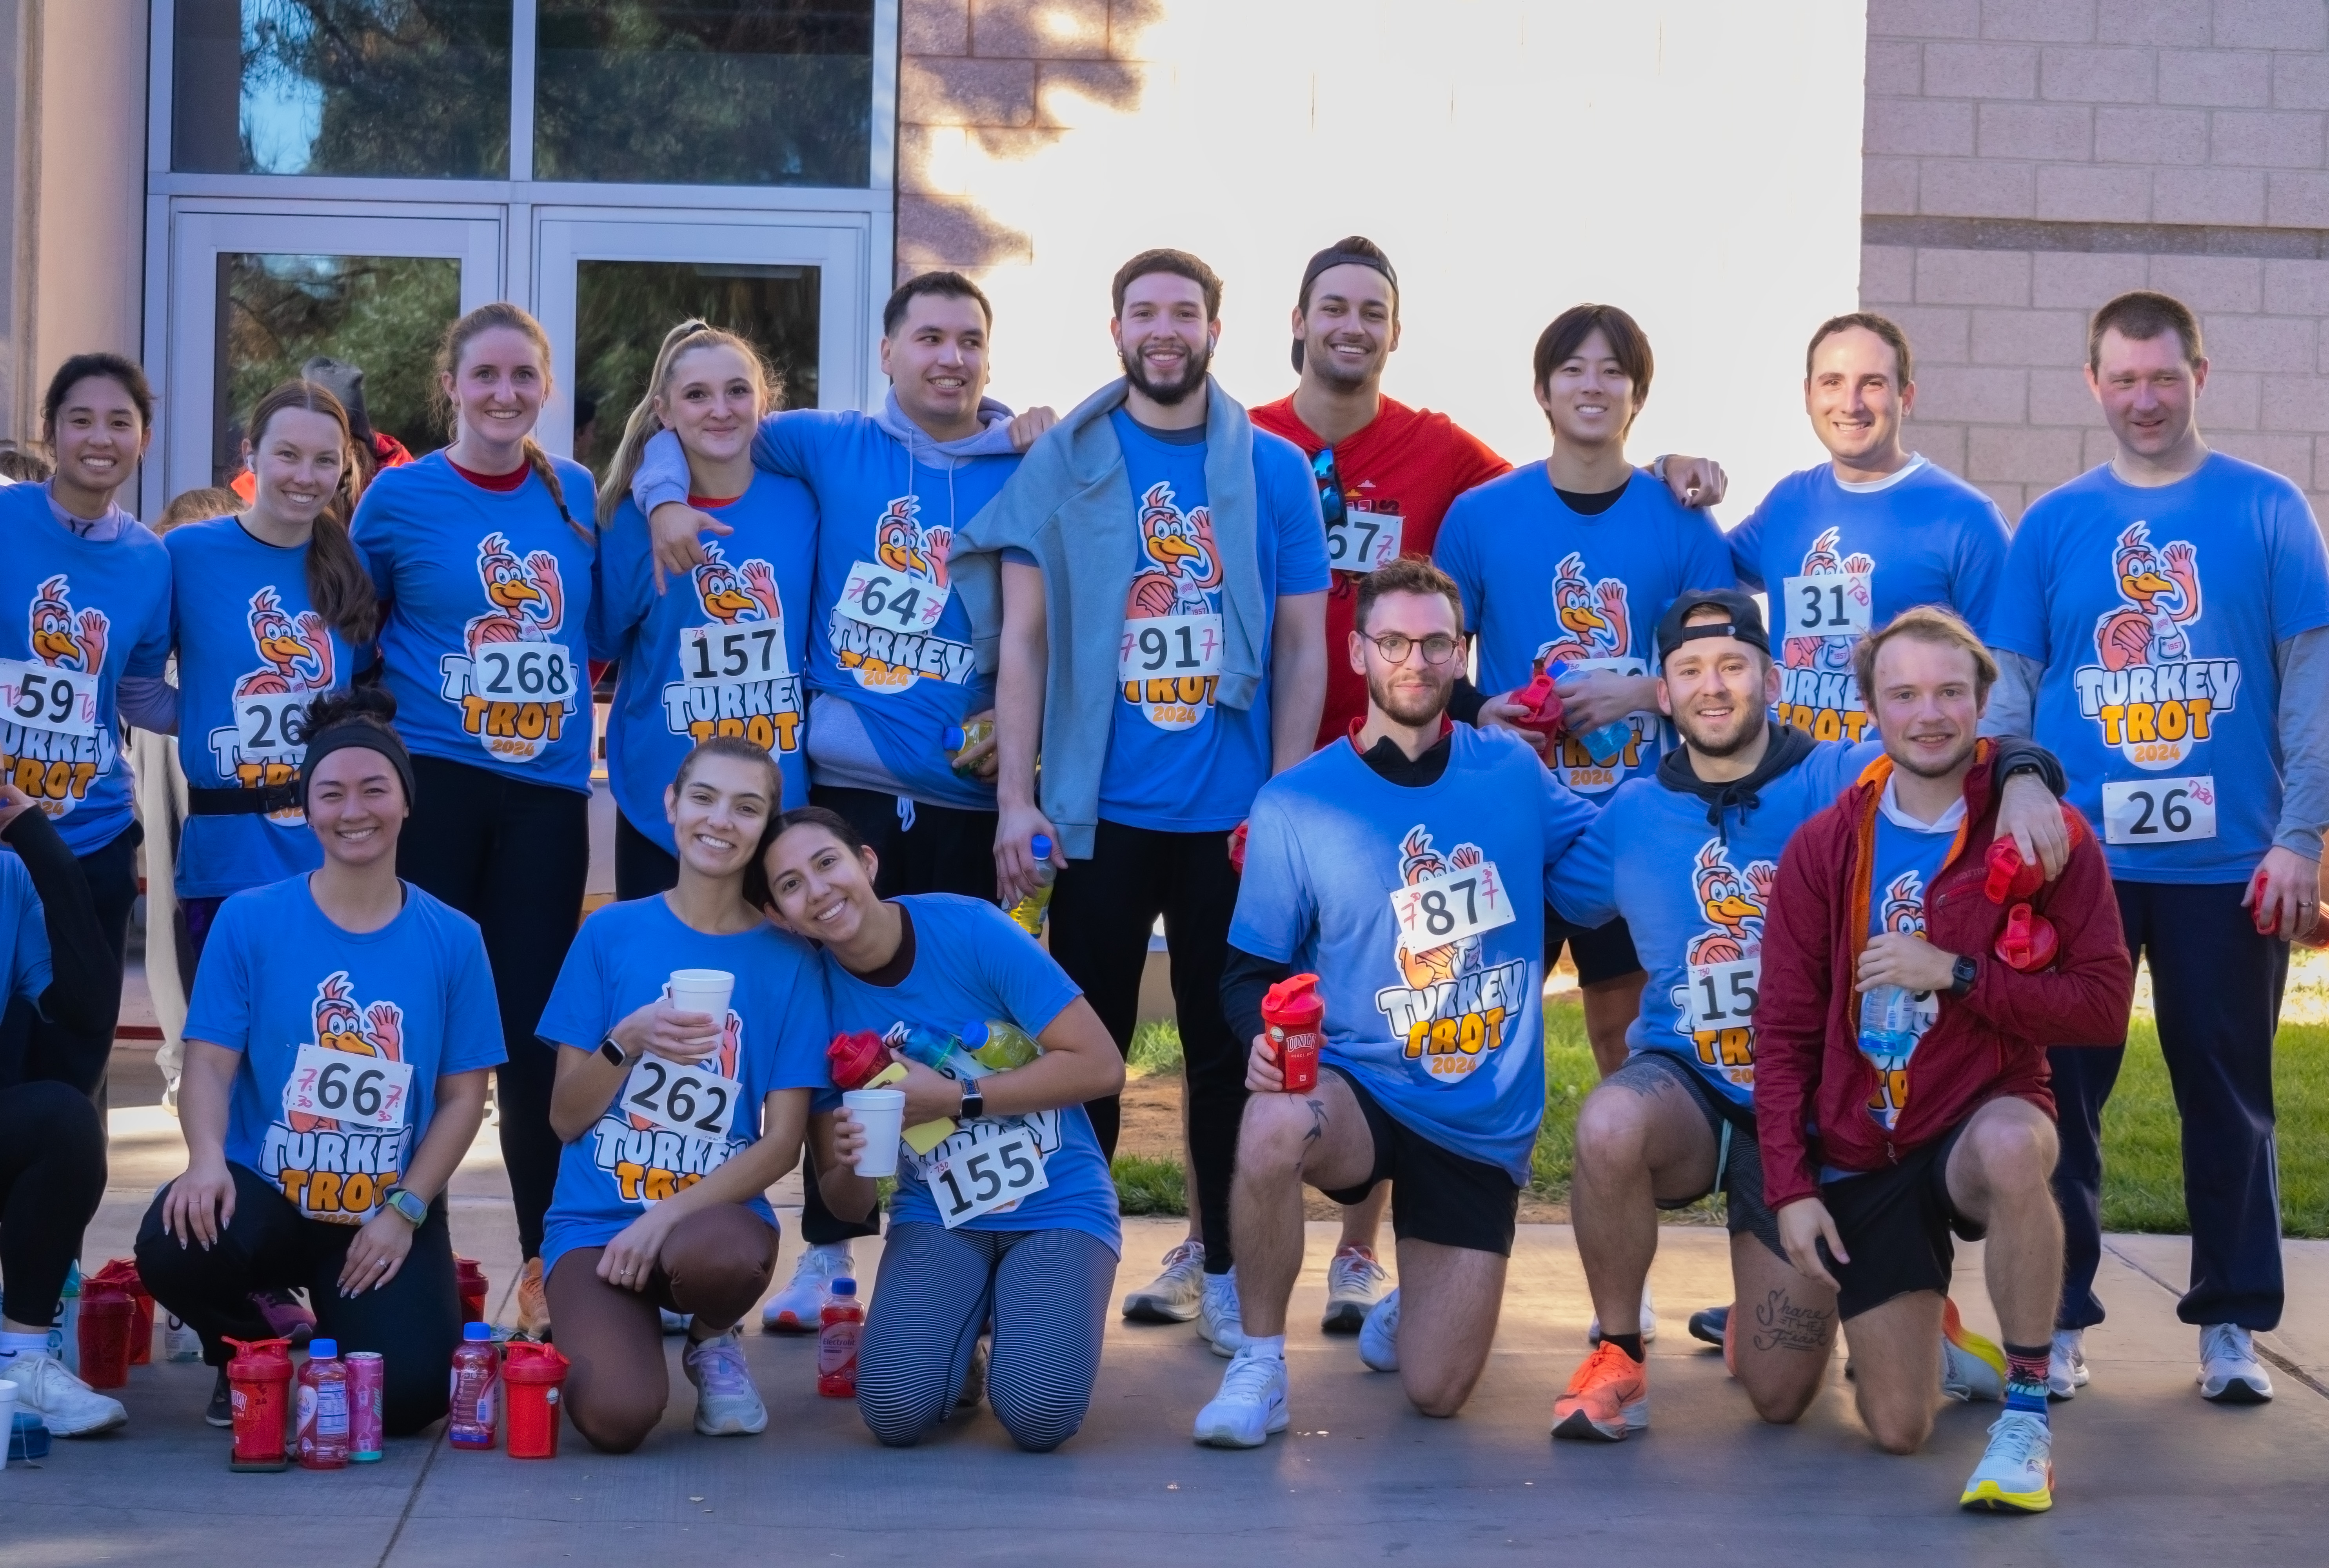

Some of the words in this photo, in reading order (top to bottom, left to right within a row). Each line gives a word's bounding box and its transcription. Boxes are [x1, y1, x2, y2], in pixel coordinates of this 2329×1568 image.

[861, 577, 921, 626] 64
[1800, 584, 1850, 628] 31
[1847, 576, 1869, 607] 730
[692, 628, 776, 679] 157
[829, 609, 975, 686] TURKEY
[1139, 626, 1201, 670] 91
[1834, 652, 1847, 660] 1957
[2167, 641, 2182, 651] 1957
[483, 652, 569, 695] 268
[863, 671, 908, 686] 2024
[2075, 660, 2240, 717] TURKEY
[14, 673, 74, 724] 59
[461, 694, 564, 741] TROT
[1152, 706, 1196, 724] 2024
[245, 703, 306, 749] 26
[2100, 698, 2213, 745] TROT
[0, 721, 116, 776] URKEY
[491, 739, 535, 756] 2024
[2135, 743, 2181, 762] 2024
[1570, 769, 1614, 786] 2024
[270, 807, 304, 819] 202
[2127, 789, 2192, 835] 26
[1421, 877, 1478, 935] 87
[1378, 960, 1525, 1038] TURKEY
[1699, 970, 1759, 1021] 15
[1286, 1033, 1317, 1053] UNLV
[1404, 1007, 1505, 1058] TROT
[1693, 1027, 1756, 1067] TR
[1431, 1057, 1477, 1074] 2024
[1730, 1068, 1753, 1083] 20
[318, 1062, 386, 1116] 66
[630, 1062, 727, 1134] 262
[279, 1169, 398, 1214] TROT
[938, 1140, 1035, 1217] 155
[231, 1390, 247, 1411] NLV
